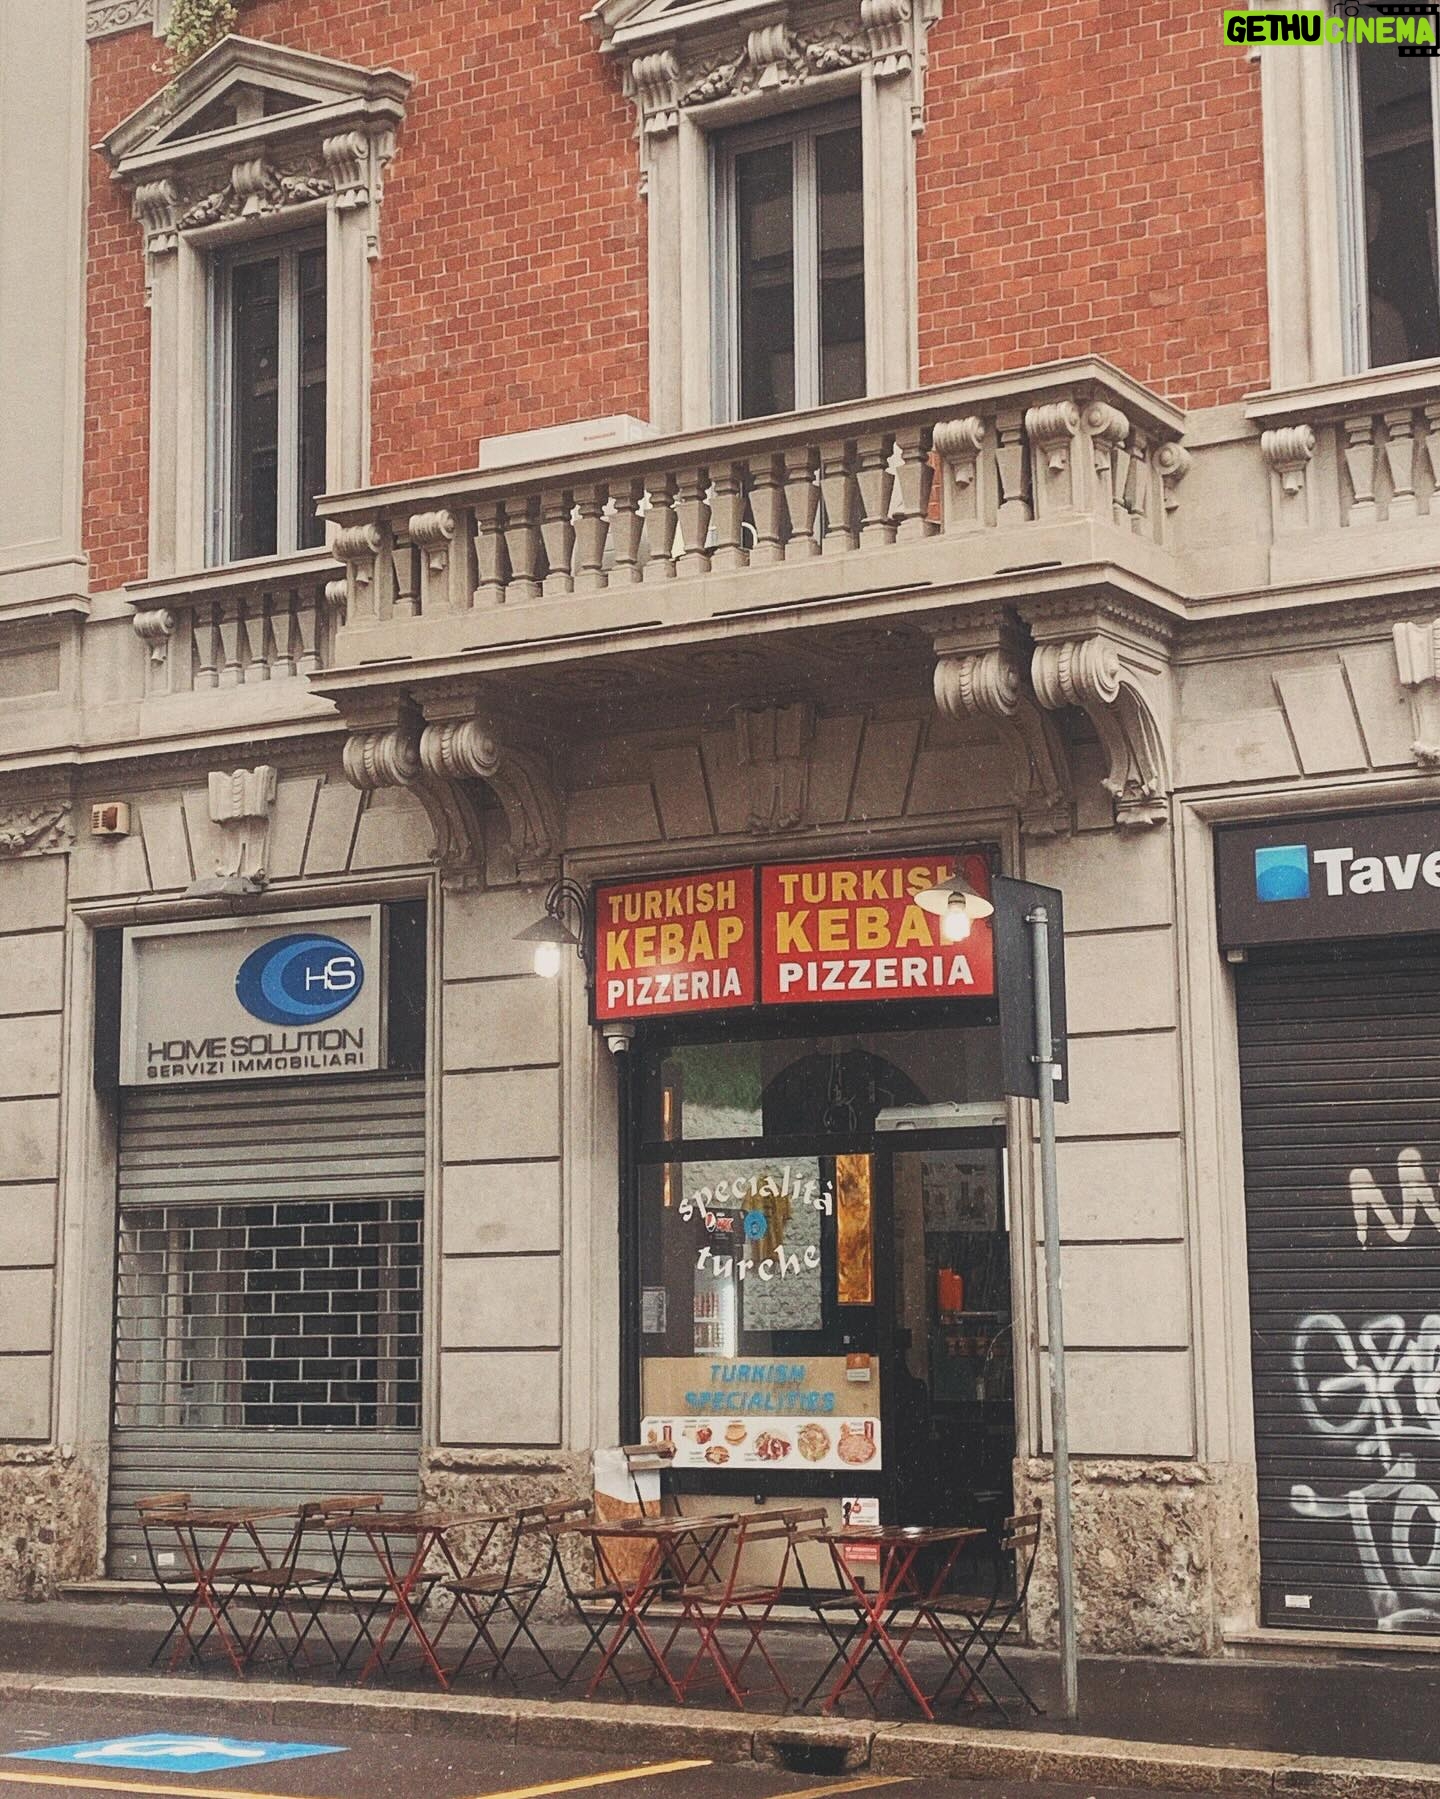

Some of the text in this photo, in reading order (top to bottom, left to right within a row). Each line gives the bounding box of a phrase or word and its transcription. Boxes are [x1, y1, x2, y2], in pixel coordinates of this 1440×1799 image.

[607, 879, 736, 924] TURKISH
[606, 916, 745, 972] KEBAP
[775, 904, 975, 954] KEBA
[305, 957, 356, 990] HS
[606, 966, 742, 1009] PIZZERIA
[778, 954, 974, 993] PIZZERIA
[146, 1052, 364, 1079] SERVIZI IMMOBILIARI
[696, 1245, 821, 1281] turche
